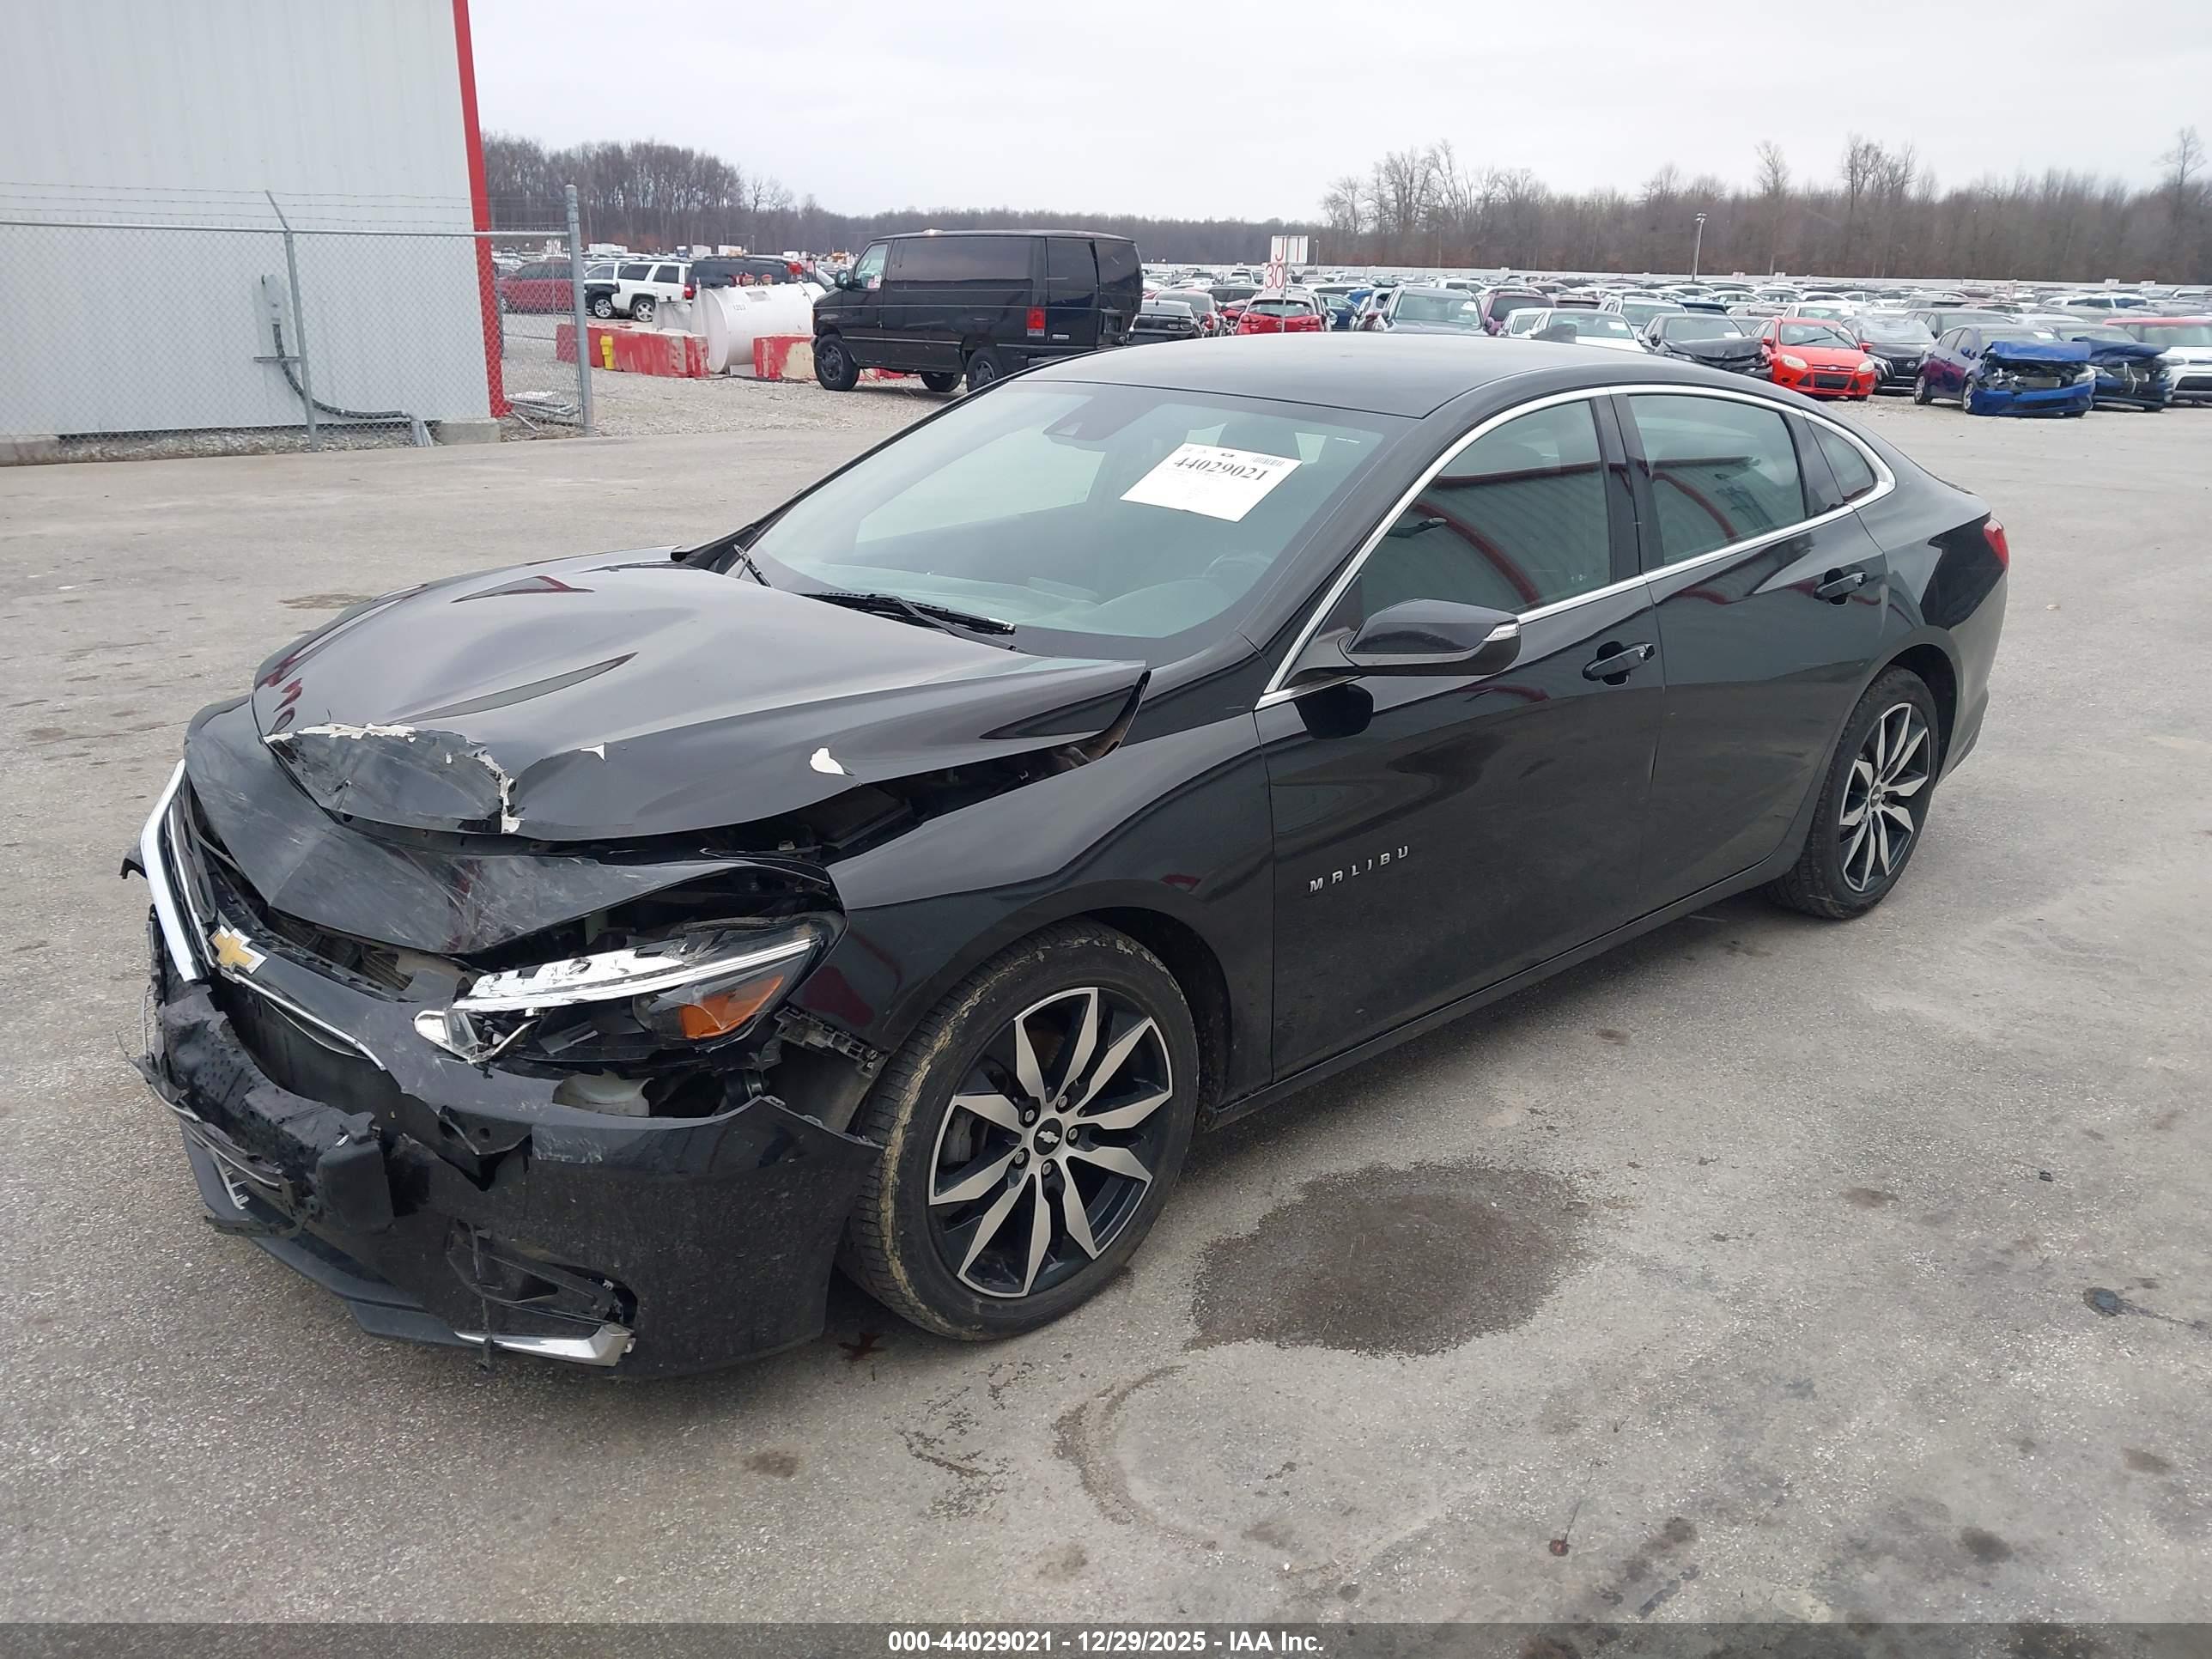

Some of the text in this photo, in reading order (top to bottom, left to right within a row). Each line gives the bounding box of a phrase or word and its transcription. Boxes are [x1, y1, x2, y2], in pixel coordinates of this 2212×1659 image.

[1265, 264, 1285, 289] 30
[1174, 457, 1269, 481] 44029021
[1310, 845, 1409, 893] MALIBU
